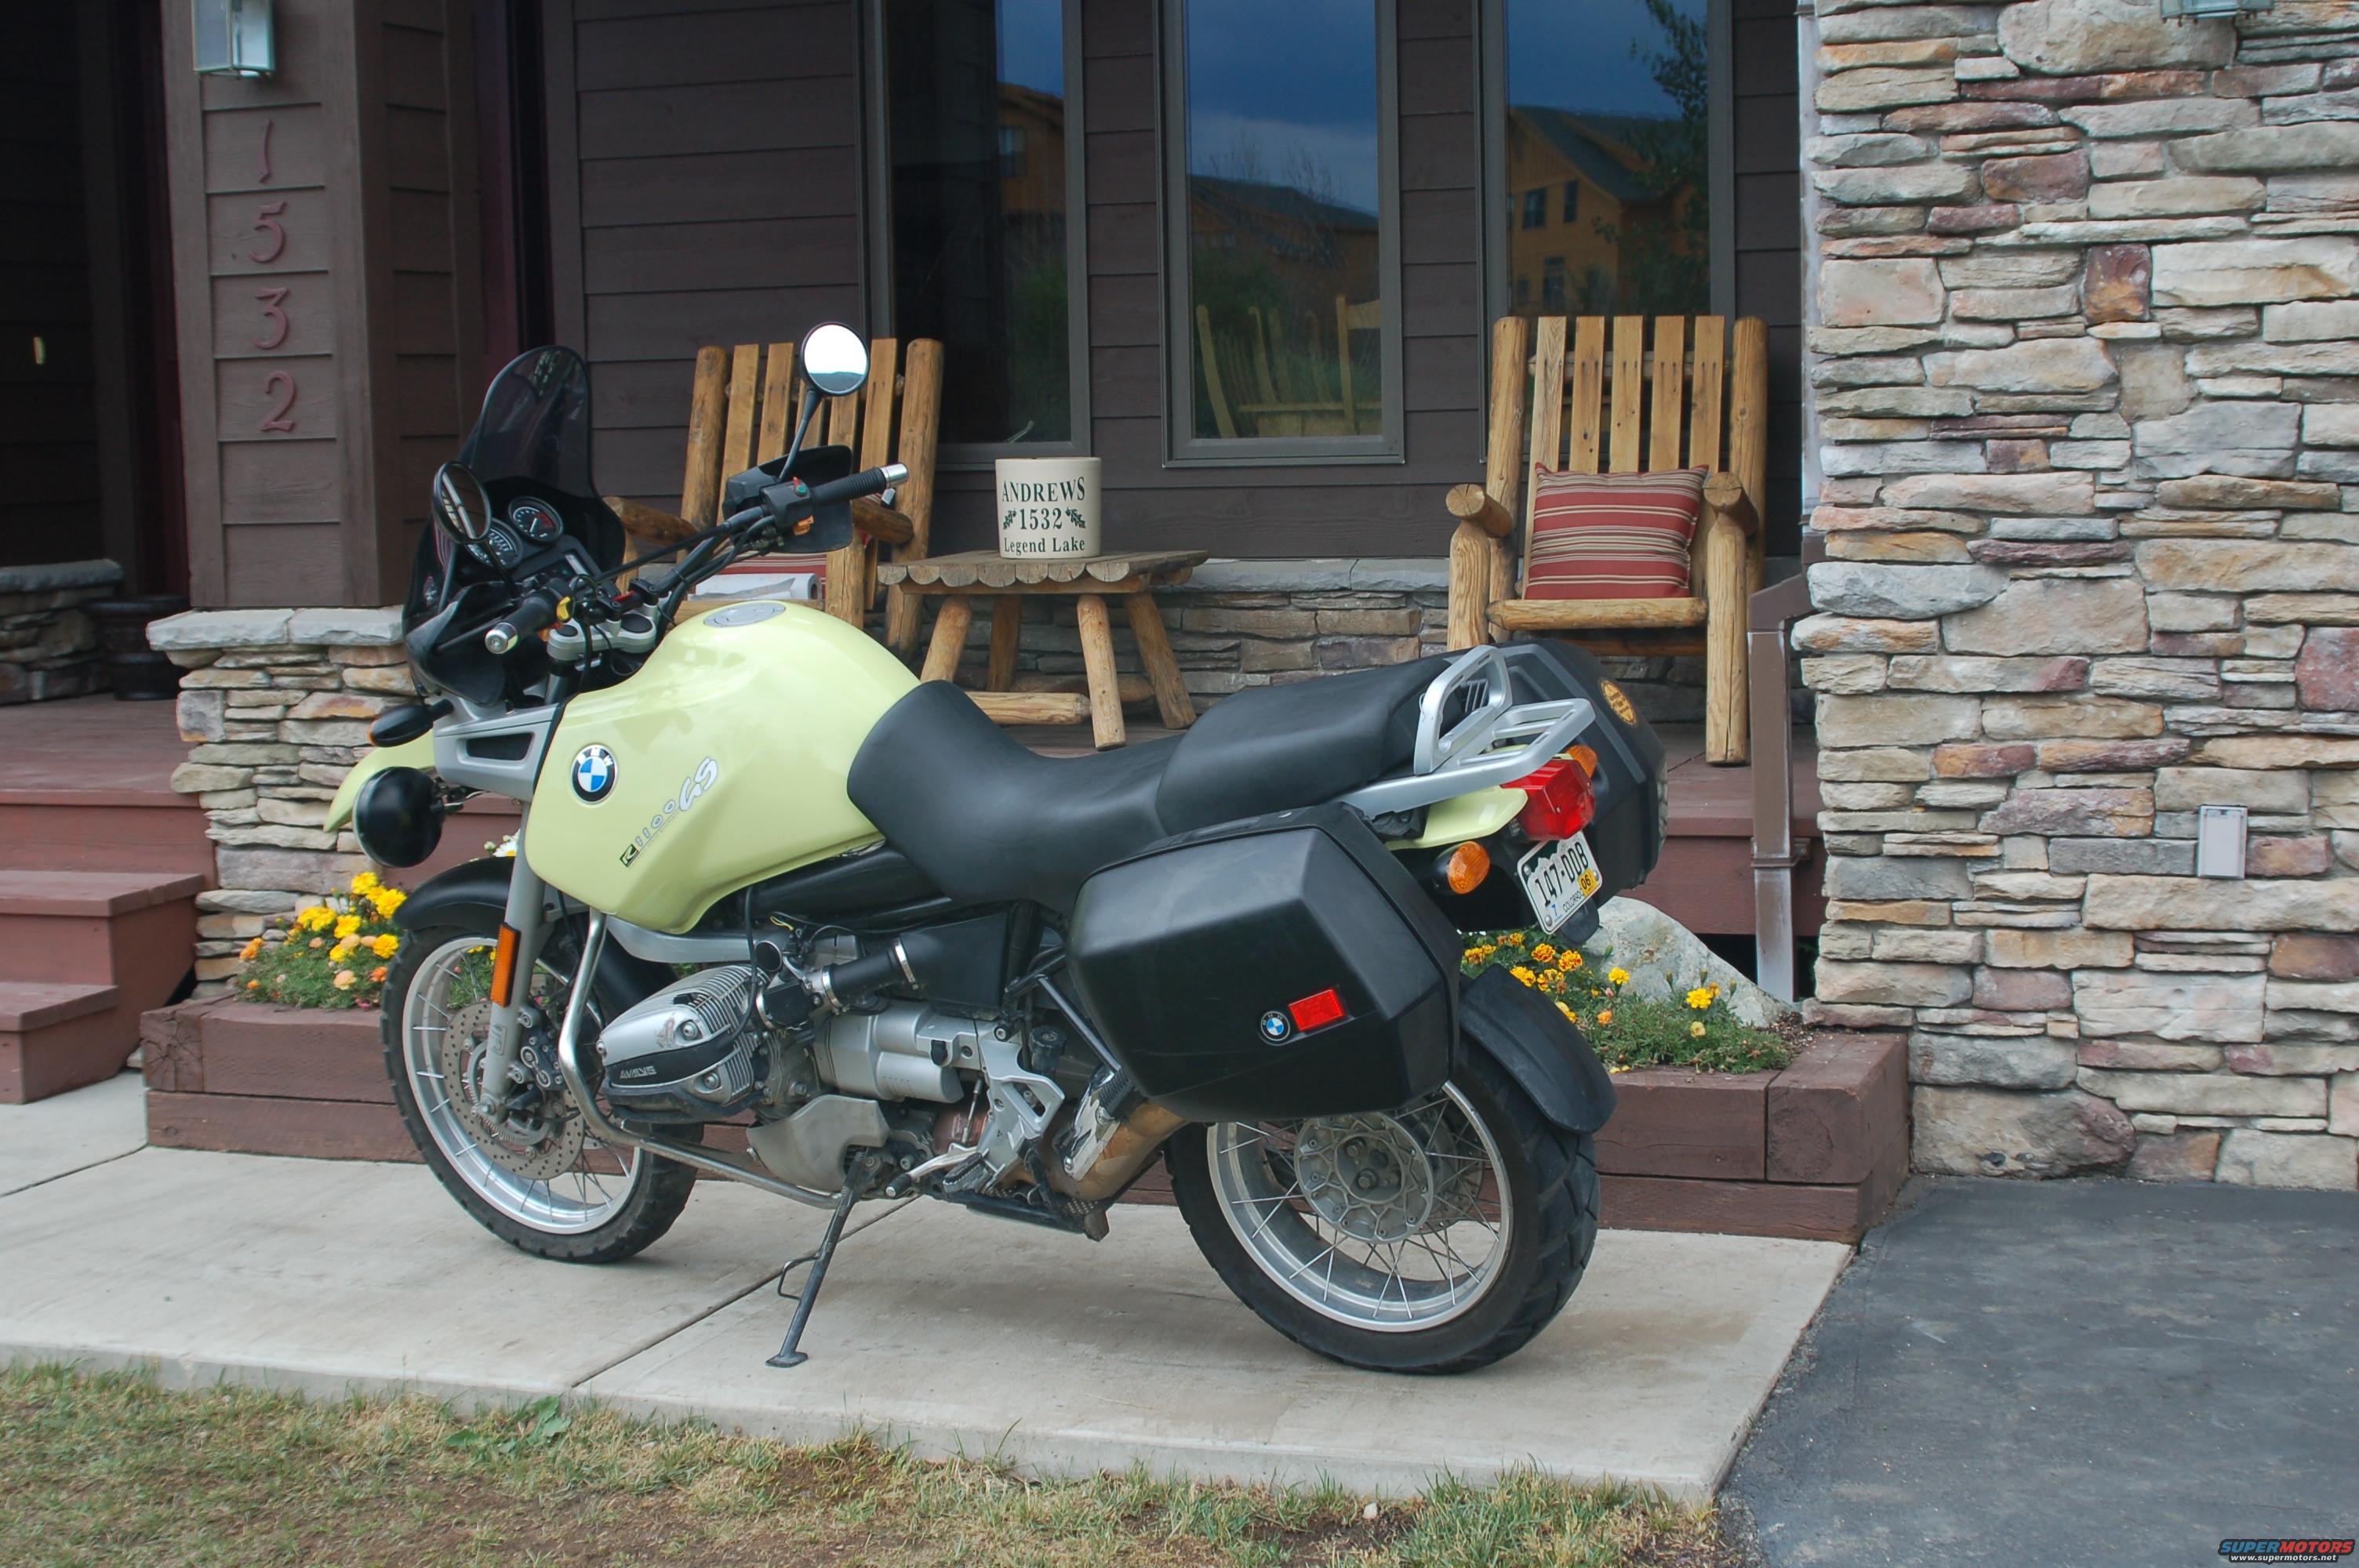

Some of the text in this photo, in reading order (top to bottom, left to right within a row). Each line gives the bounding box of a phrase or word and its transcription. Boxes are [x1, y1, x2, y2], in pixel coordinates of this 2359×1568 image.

[248, 118, 296, 433] 1532
[1002, 476, 1085, 503] ANDREWS
[1020, 507, 1063, 531] 1532
[1004, 536, 1085, 556] Legend Lake
[1580, 874, 1591, 889] 06
